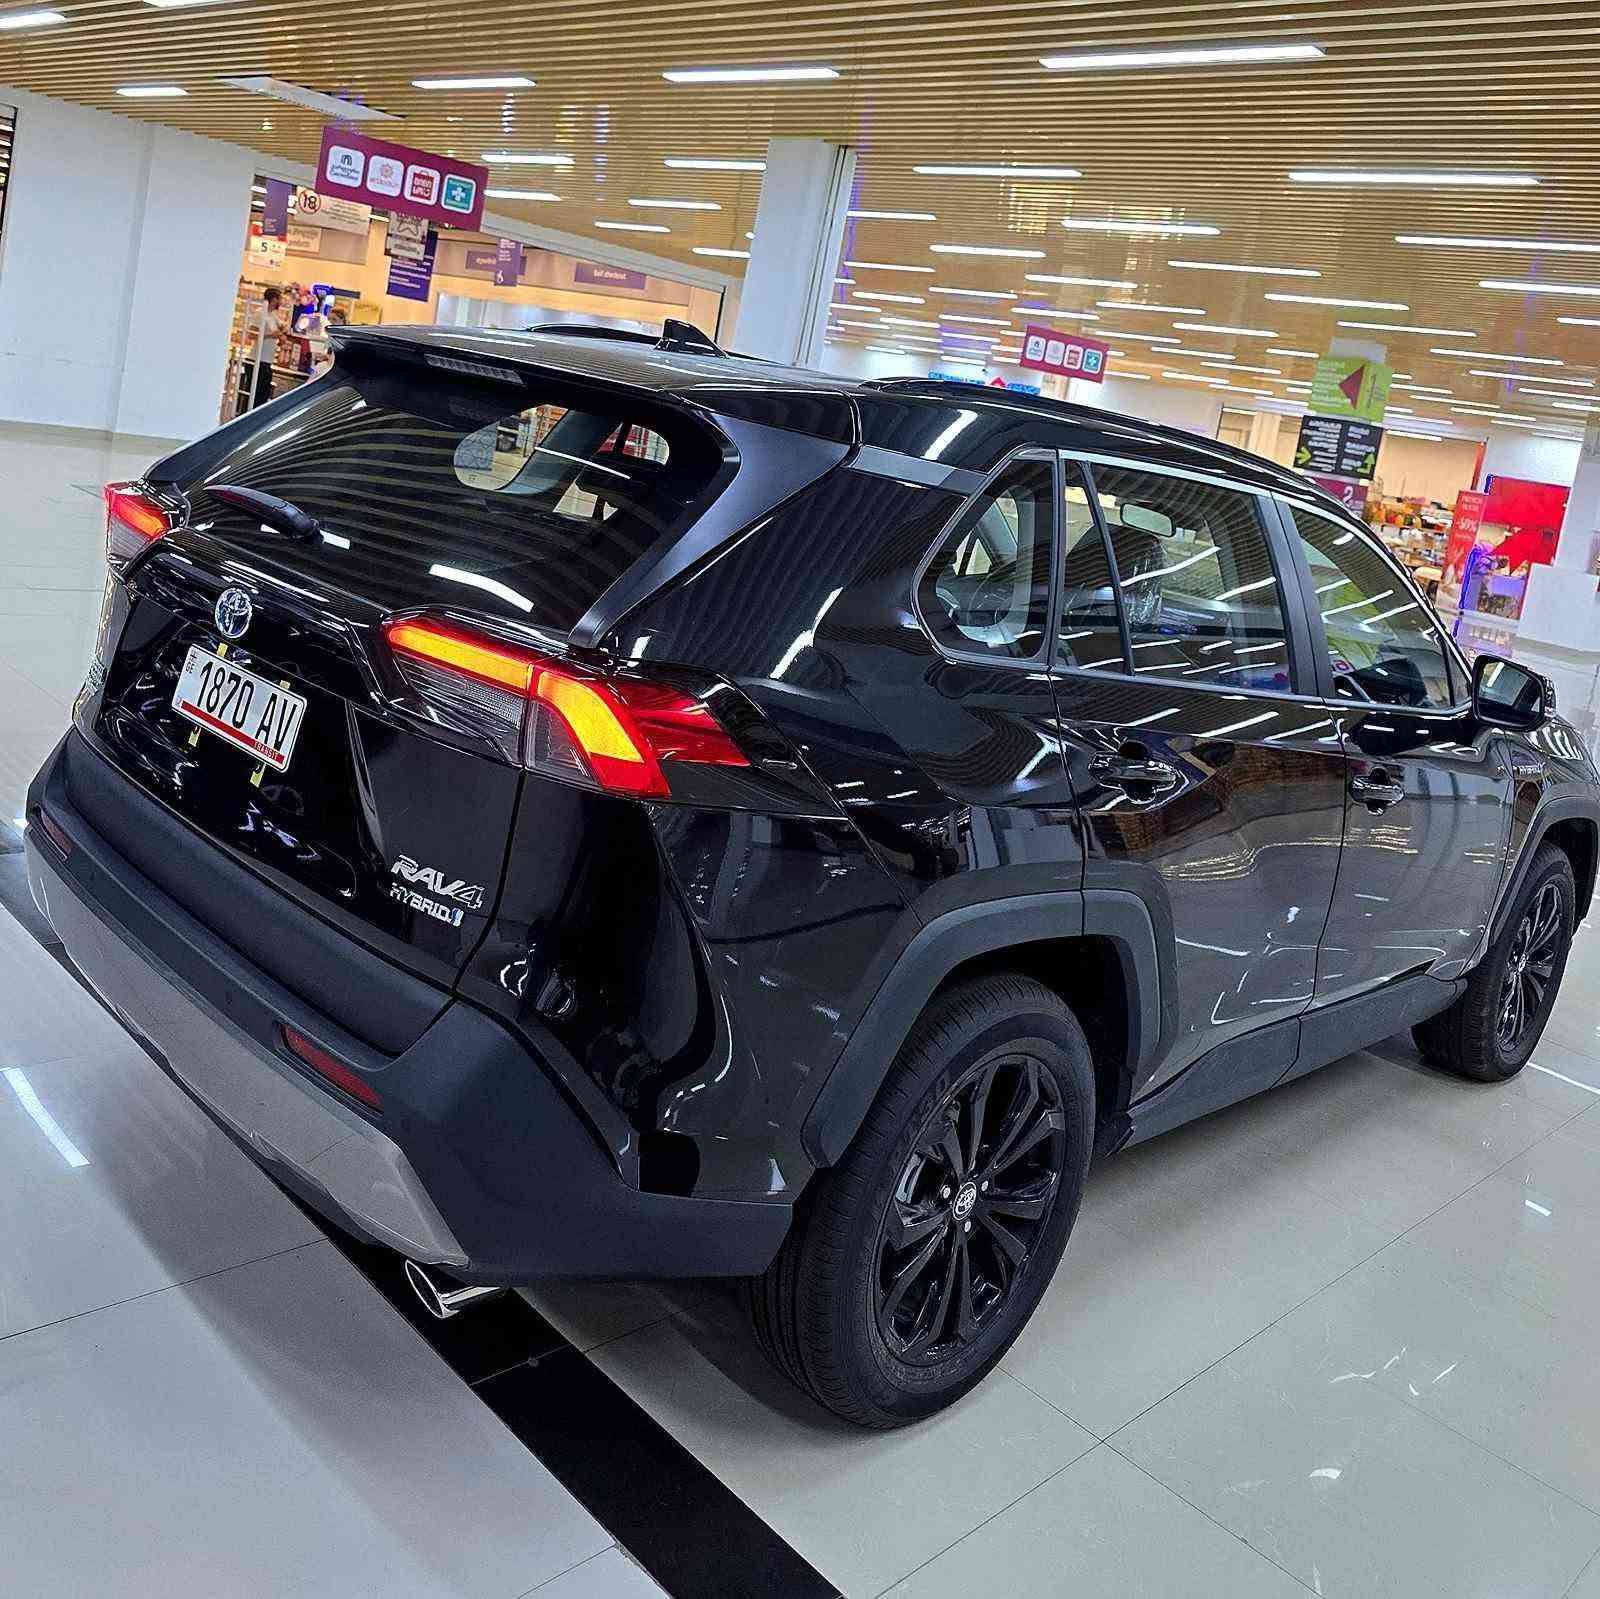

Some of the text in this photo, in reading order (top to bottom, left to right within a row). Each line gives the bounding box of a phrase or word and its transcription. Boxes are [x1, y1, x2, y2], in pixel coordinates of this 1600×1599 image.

[302, 194, 318, 210] 18
[197, 661, 298, 752] 1870 AV
[255, 740, 278, 761] TRANSIT
[390, 854, 485, 909] RAV4
[390, 882, 452, 924] HYBRID
